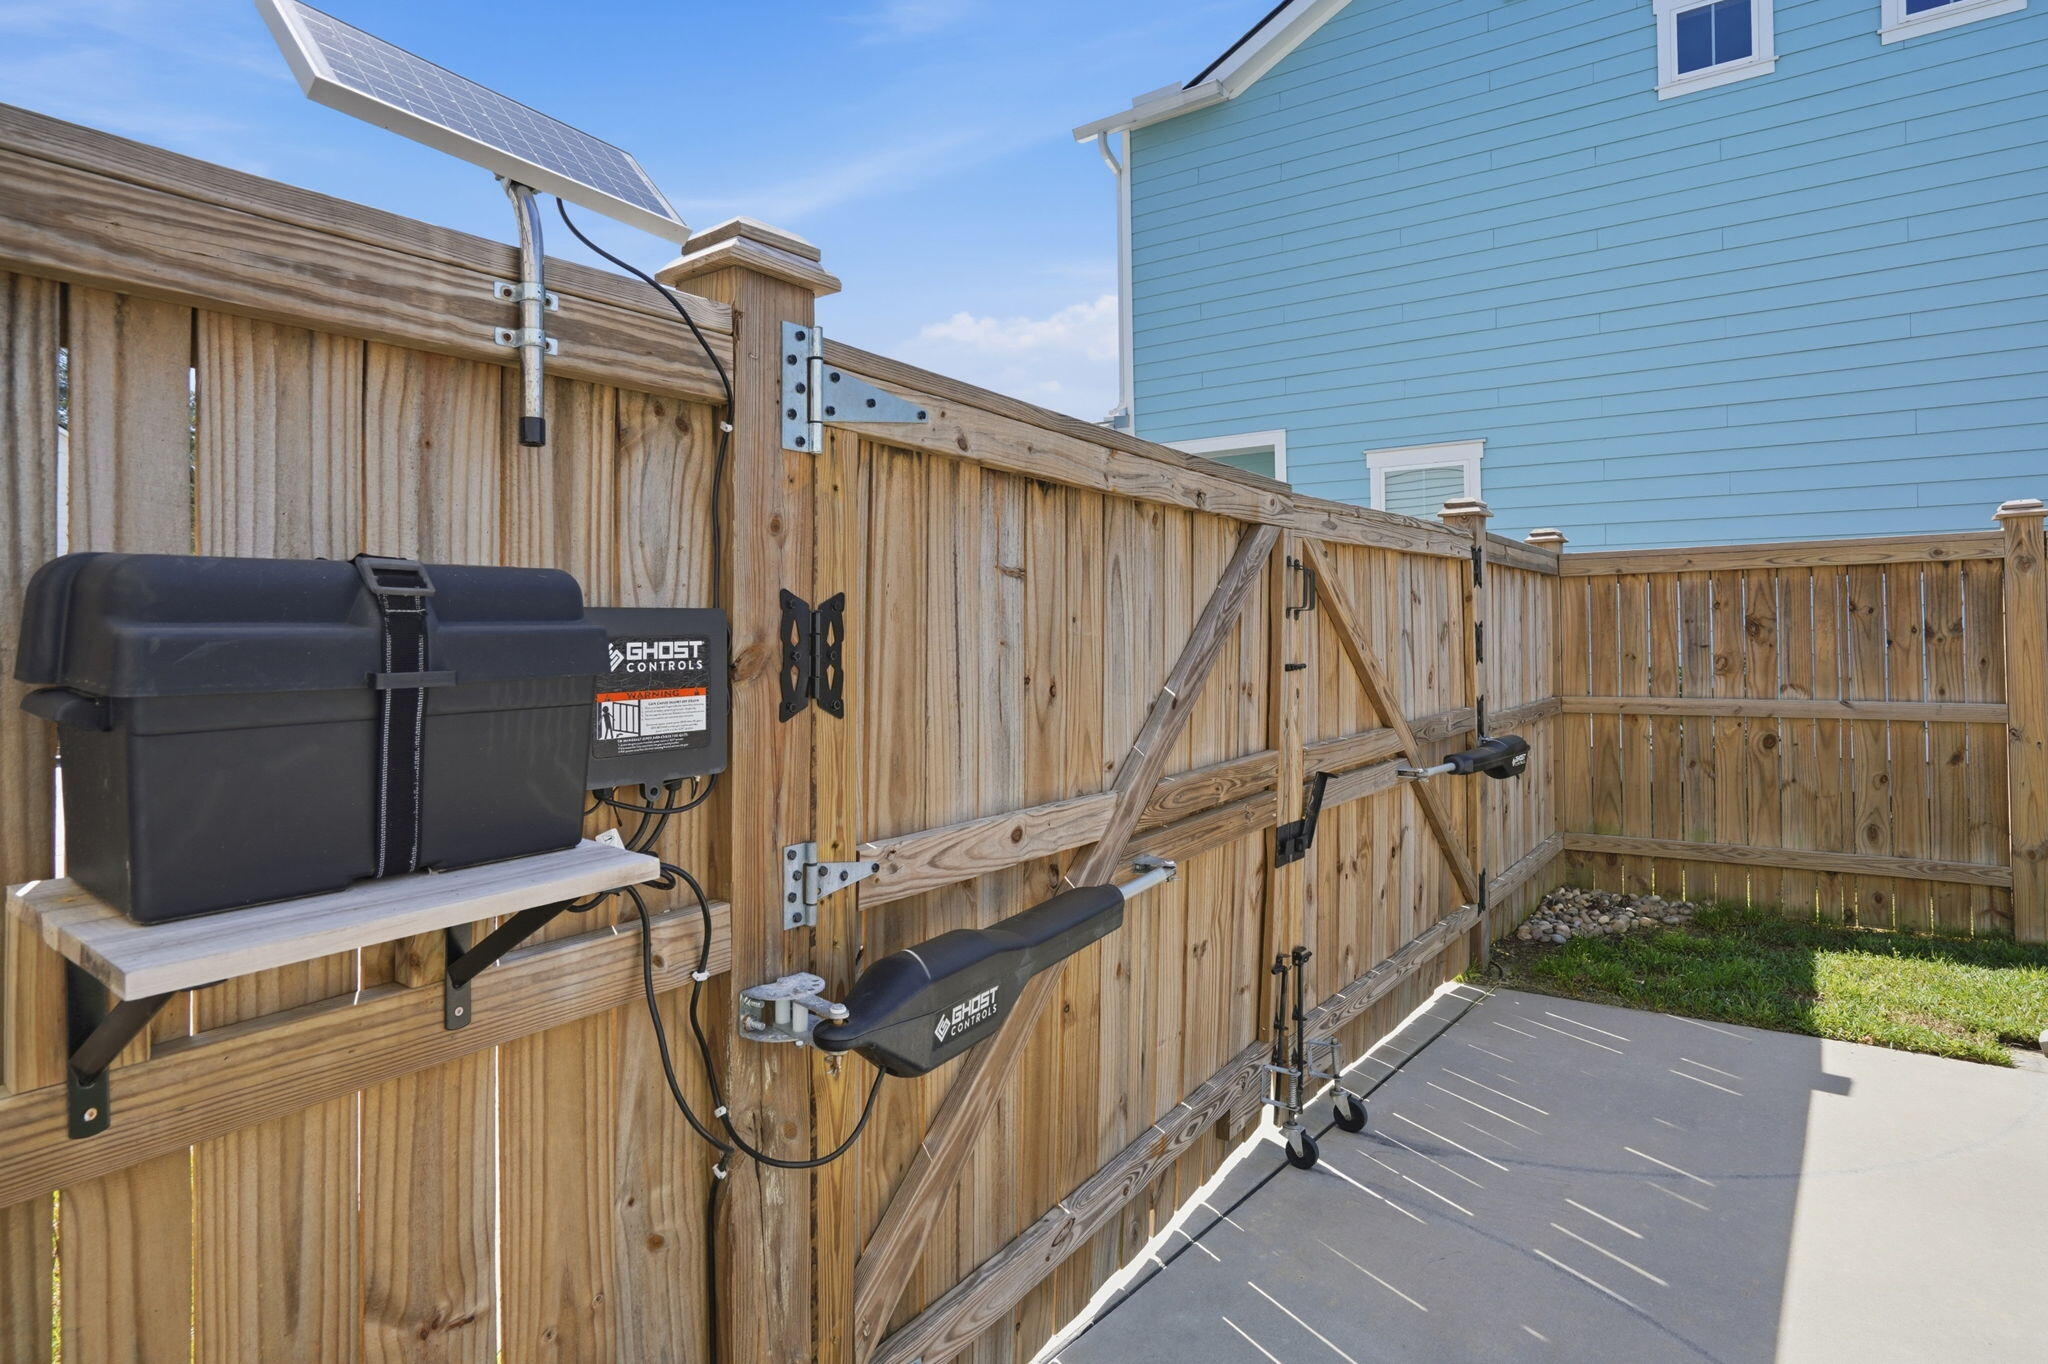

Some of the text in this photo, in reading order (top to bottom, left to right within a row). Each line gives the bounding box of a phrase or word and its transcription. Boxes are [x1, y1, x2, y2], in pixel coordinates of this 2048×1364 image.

[626, 640, 703, 660] GHOST
[626, 660, 703, 673] CONTROLS
[626, 689, 680, 699] WARNING
[951, 986, 998, 1025] GHOST
[951, 1004, 997, 1036] CONTROLS
